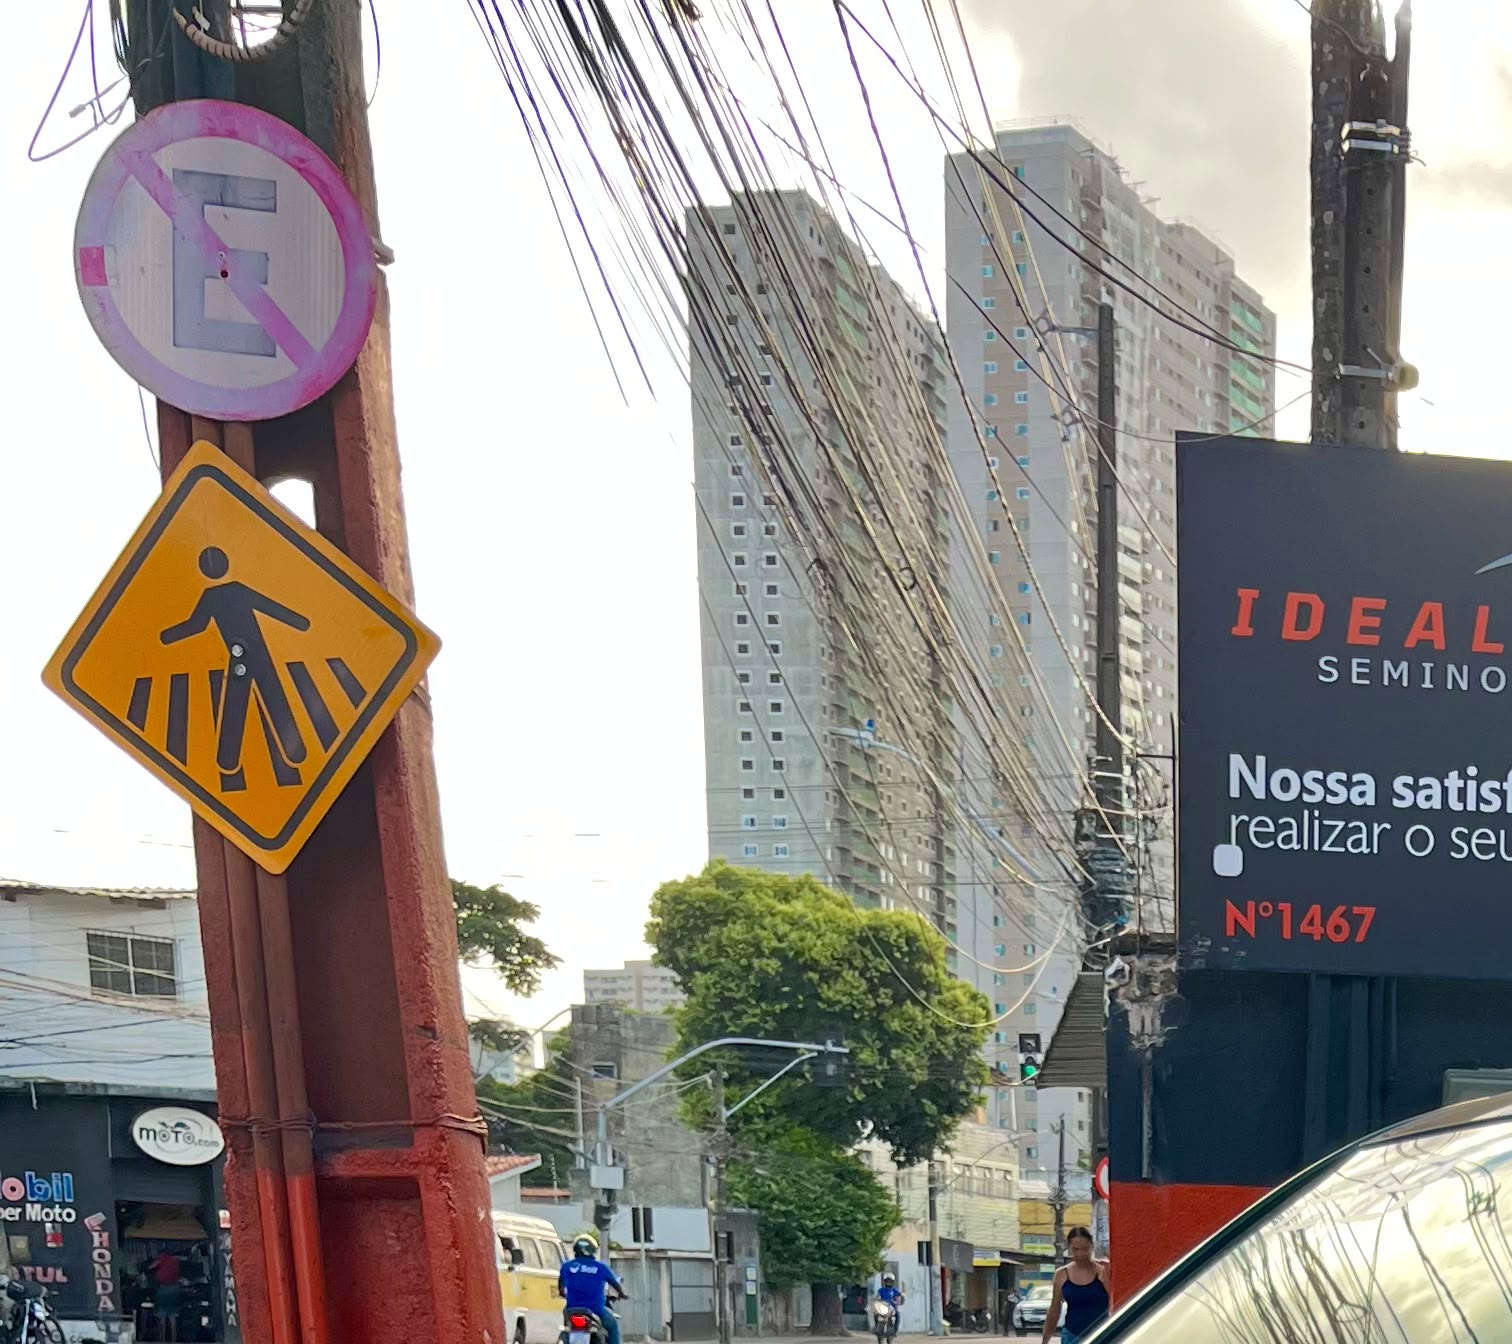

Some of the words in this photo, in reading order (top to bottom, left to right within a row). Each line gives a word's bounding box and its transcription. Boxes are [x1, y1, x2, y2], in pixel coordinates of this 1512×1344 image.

[173, 168, 277, 358] E
[1228, 753, 1376, 807] Nossa
[1229, 810, 1391, 855] realizar
[1404, 823, 1436, 858] o
[0, 1171, 74, 1203] obil
[25, 1203, 77, 1223] Moto
[92, 1231, 115, 1312] HONDA
